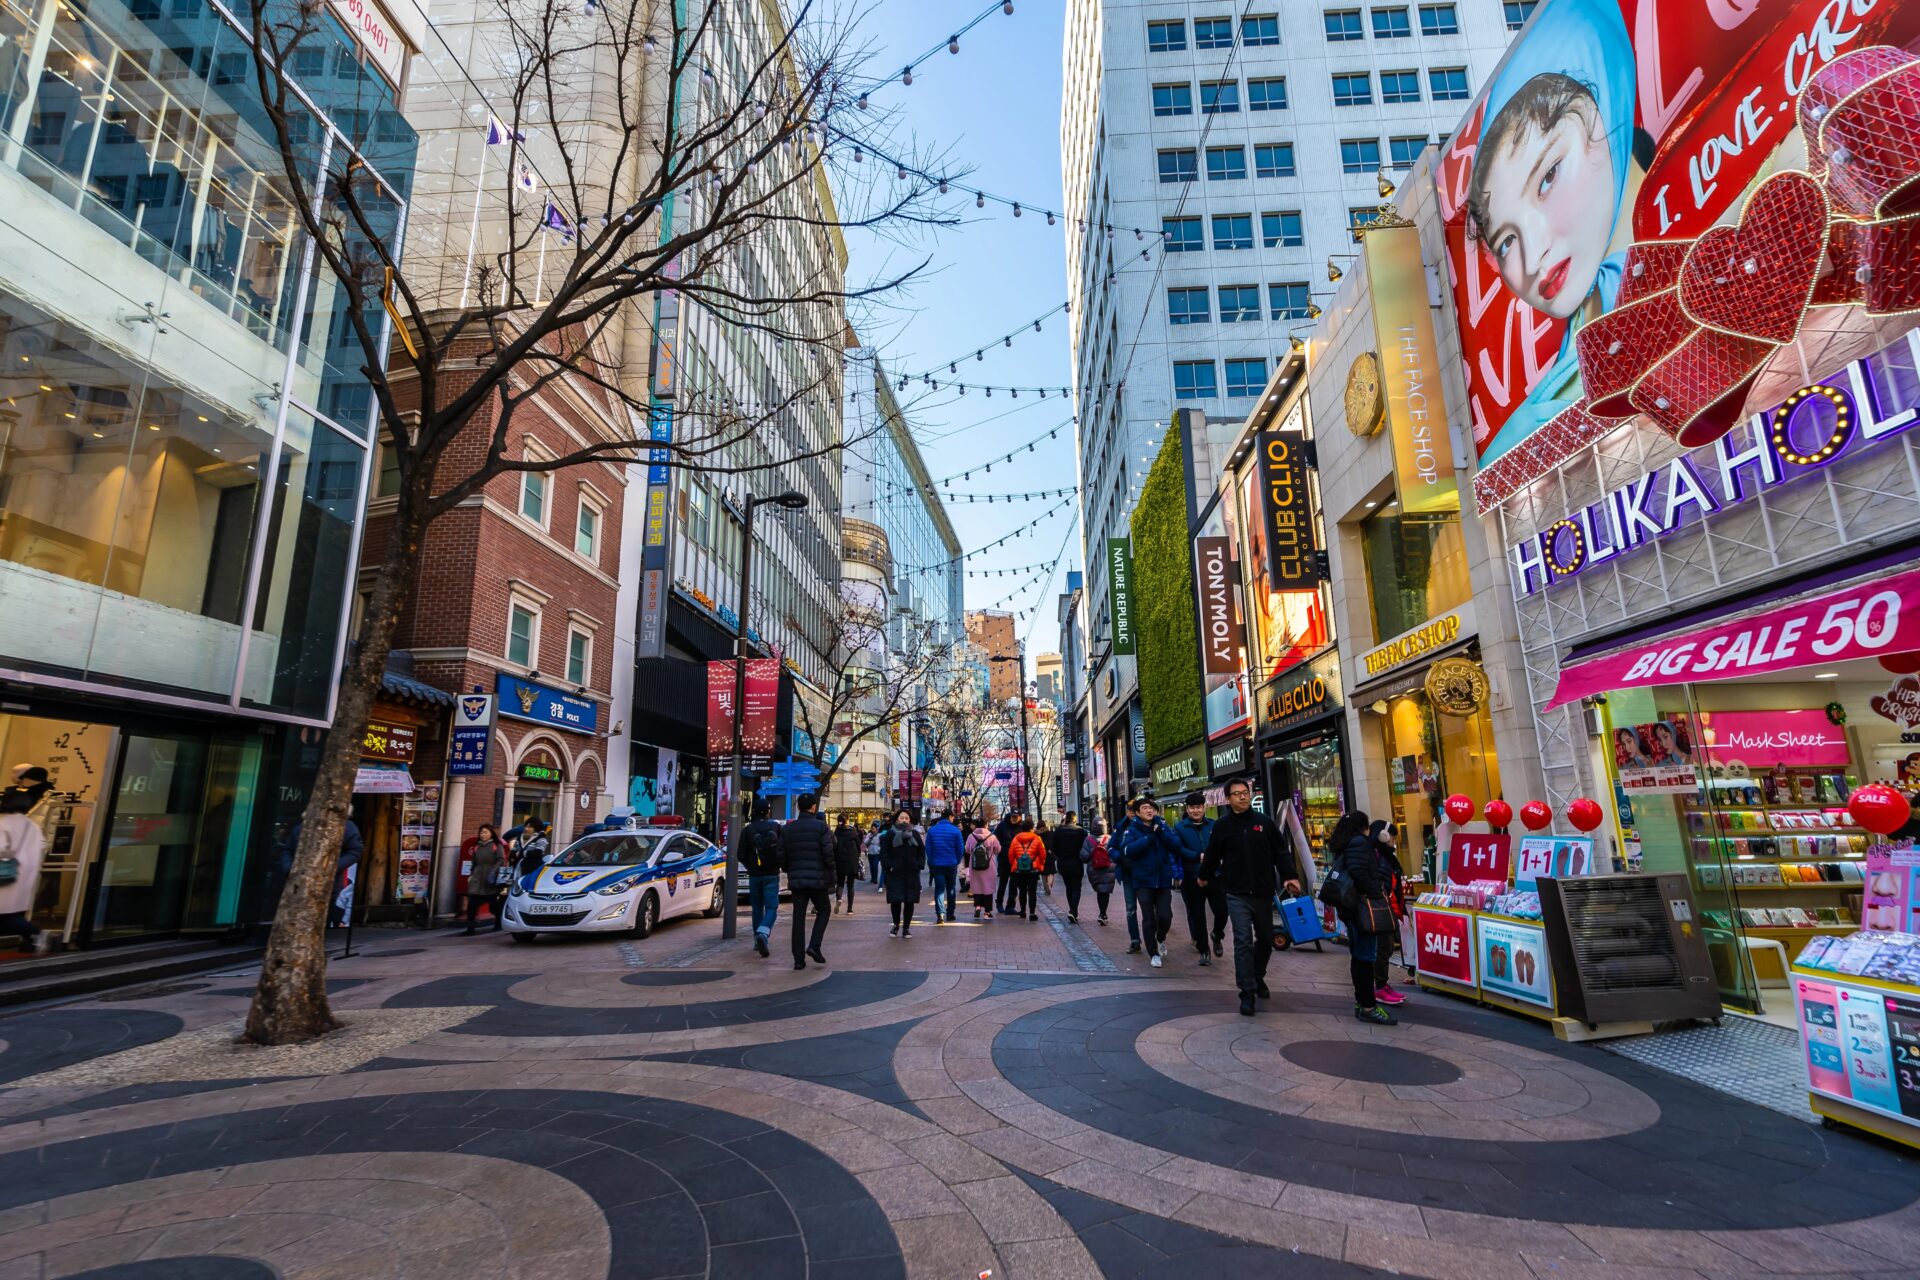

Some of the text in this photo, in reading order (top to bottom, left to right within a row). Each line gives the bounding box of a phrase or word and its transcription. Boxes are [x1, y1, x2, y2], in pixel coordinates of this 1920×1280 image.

[364, 13, 389, 54] 0401
[1398, 324, 1438, 485] THE FACE SHOP
[1515, 456, 1721, 594] HOLIKA
[1113, 547, 1128, 644] NATURE REPUBLIC
[1207, 546, 1231, 661] TONYMOLY
[643, 614, 659, 645] 안과
[1622, 642, 1698, 682] BIG
[1691, 616, 1808, 672] SALE
[550, 702, 564, 719] 경찰
[566, 713, 580, 723] POLICE
[718, 692, 732, 709] 빛
[1135, 725, 1146, 752] FOLDER
[1729, 731, 1827, 749] Mask Sheet
[1212, 745, 1241, 770] TONYMOLY
[1155, 758, 1195, 785] NATURE REPUBLIC
[1451, 801, 1469, 809] SALE
[1528, 806, 1545, 816] SALE
[1858, 794, 1889, 804] SALE
[1462, 842, 1498, 869] 1+1
[1521, 849, 1552, 874] 1+1
[550, 905, 568, 913] 9745
[1424, 932, 1460, 958] SALE
